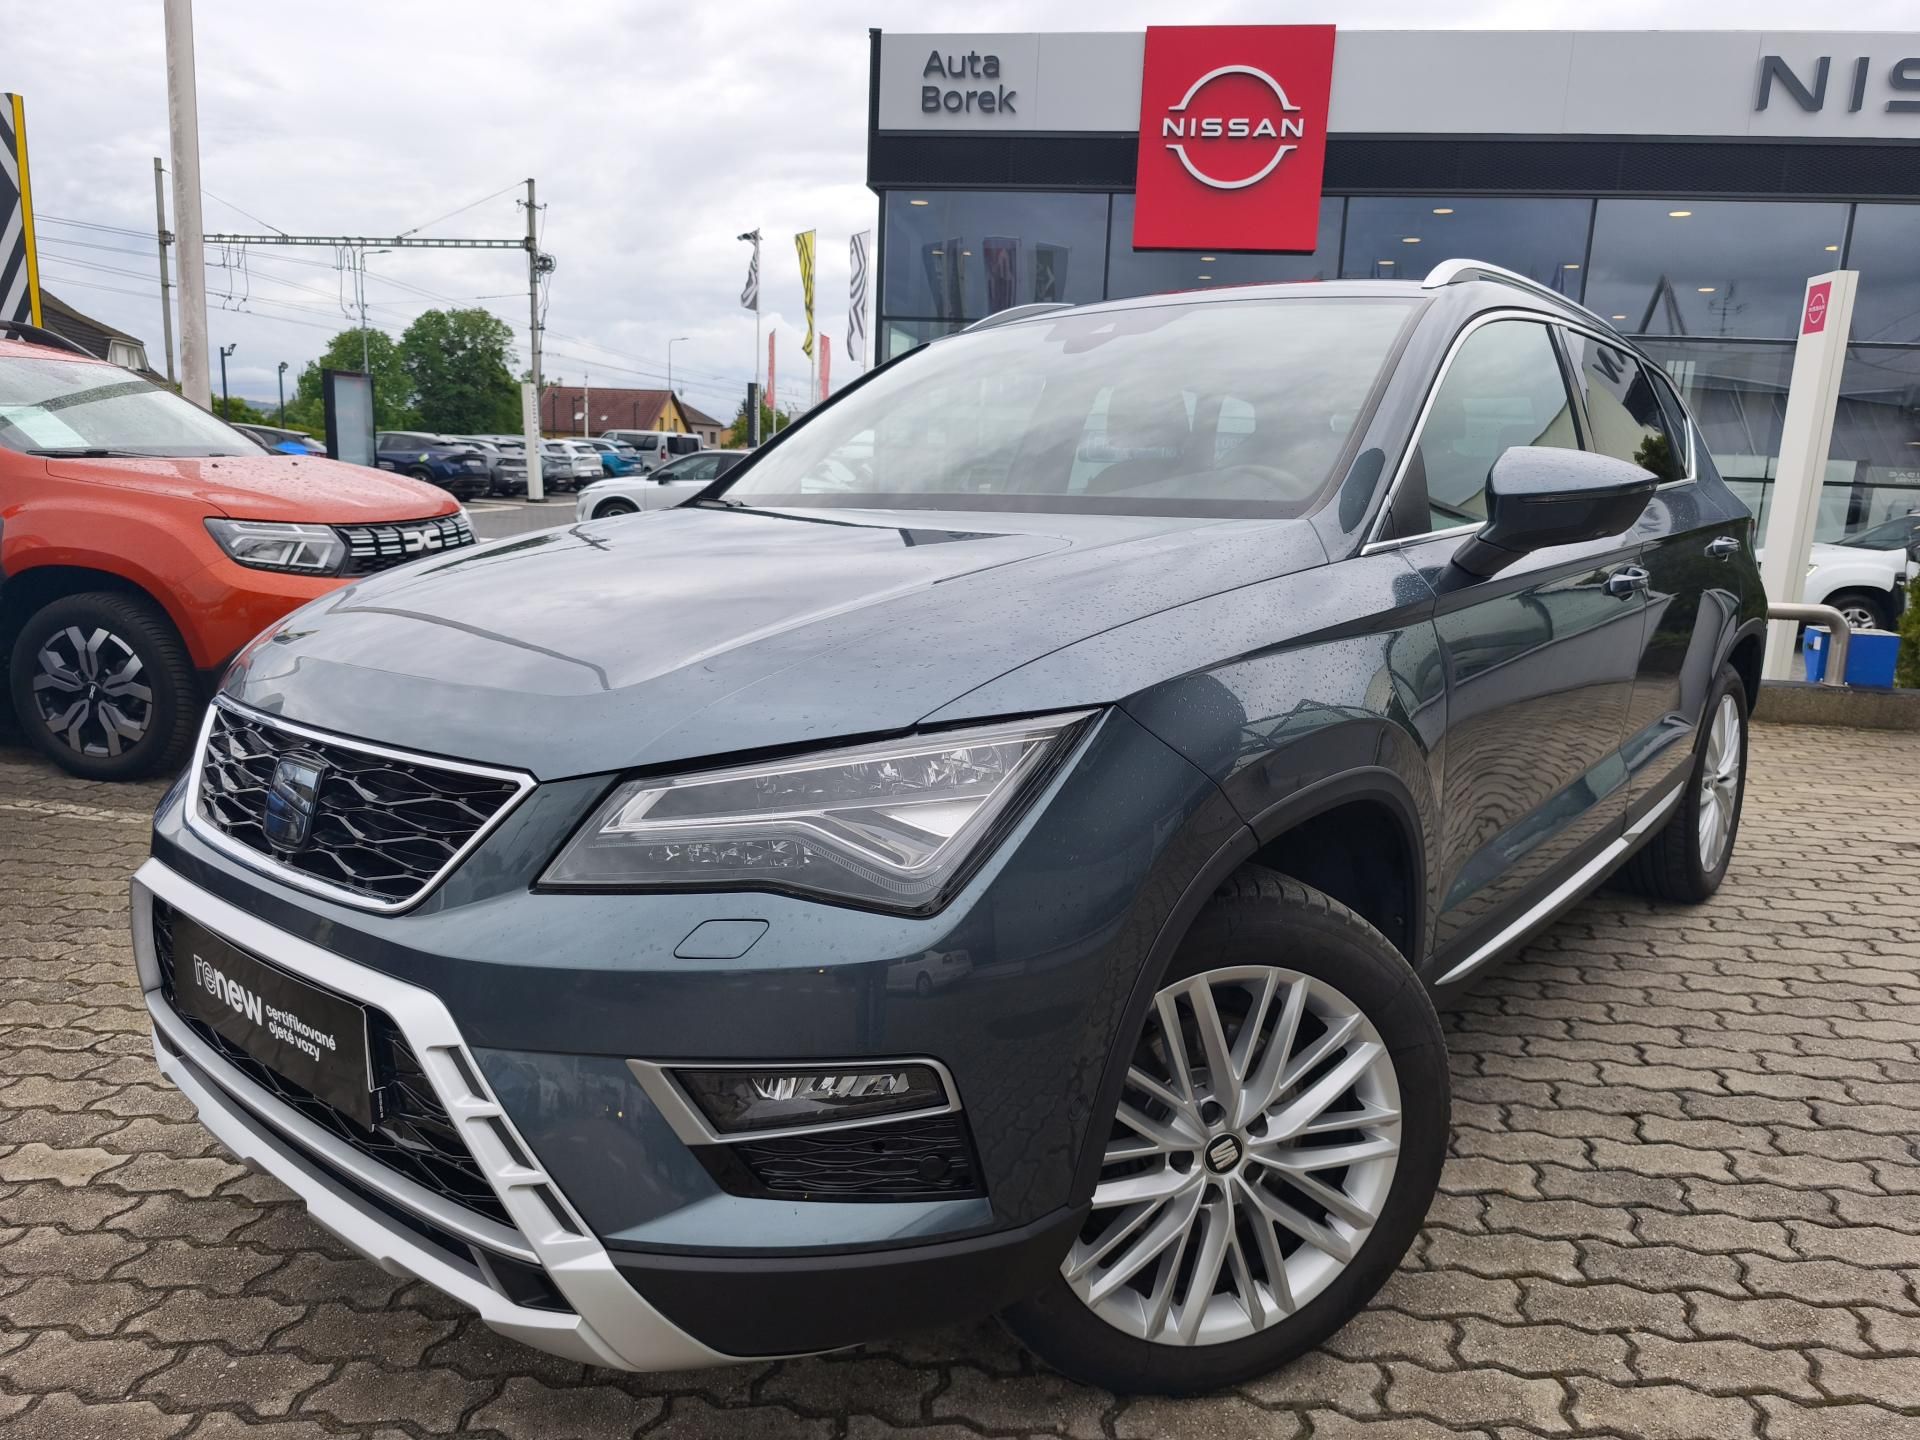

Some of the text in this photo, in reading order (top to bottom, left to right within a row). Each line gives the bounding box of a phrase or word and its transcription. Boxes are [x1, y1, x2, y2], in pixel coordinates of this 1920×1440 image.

[923, 50, 1000, 78] Auta
[921, 84, 1016, 113] Borek
[1162, 118, 1304, 137] NISSAN
[193, 954, 263, 1026] renew
[265, 1004, 337, 1051] certifikované
[268, 1021, 321, 1062] ojeté vozy
